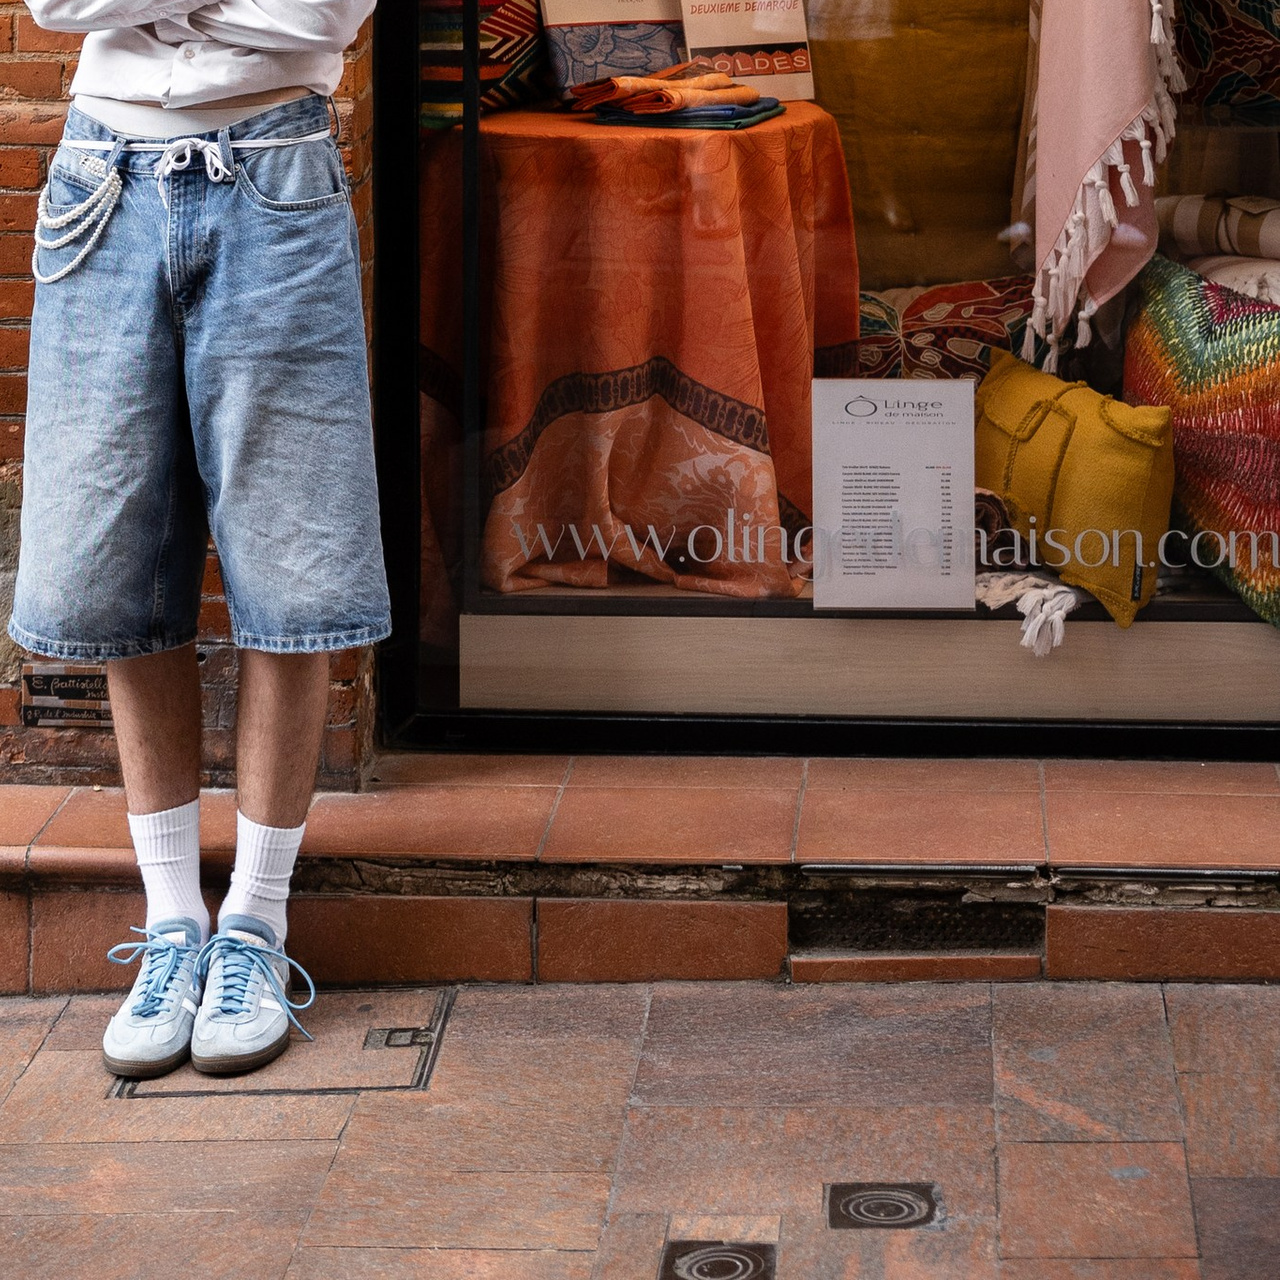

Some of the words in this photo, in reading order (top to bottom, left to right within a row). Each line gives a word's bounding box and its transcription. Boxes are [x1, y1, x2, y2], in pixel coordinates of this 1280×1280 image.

[691, 2, 740, 15] DEUXIEME
[745, 0, 799, 12] DEMARQUE
[698, 56, 807, 72] OLDES
[884, 400, 943, 411] Linge
